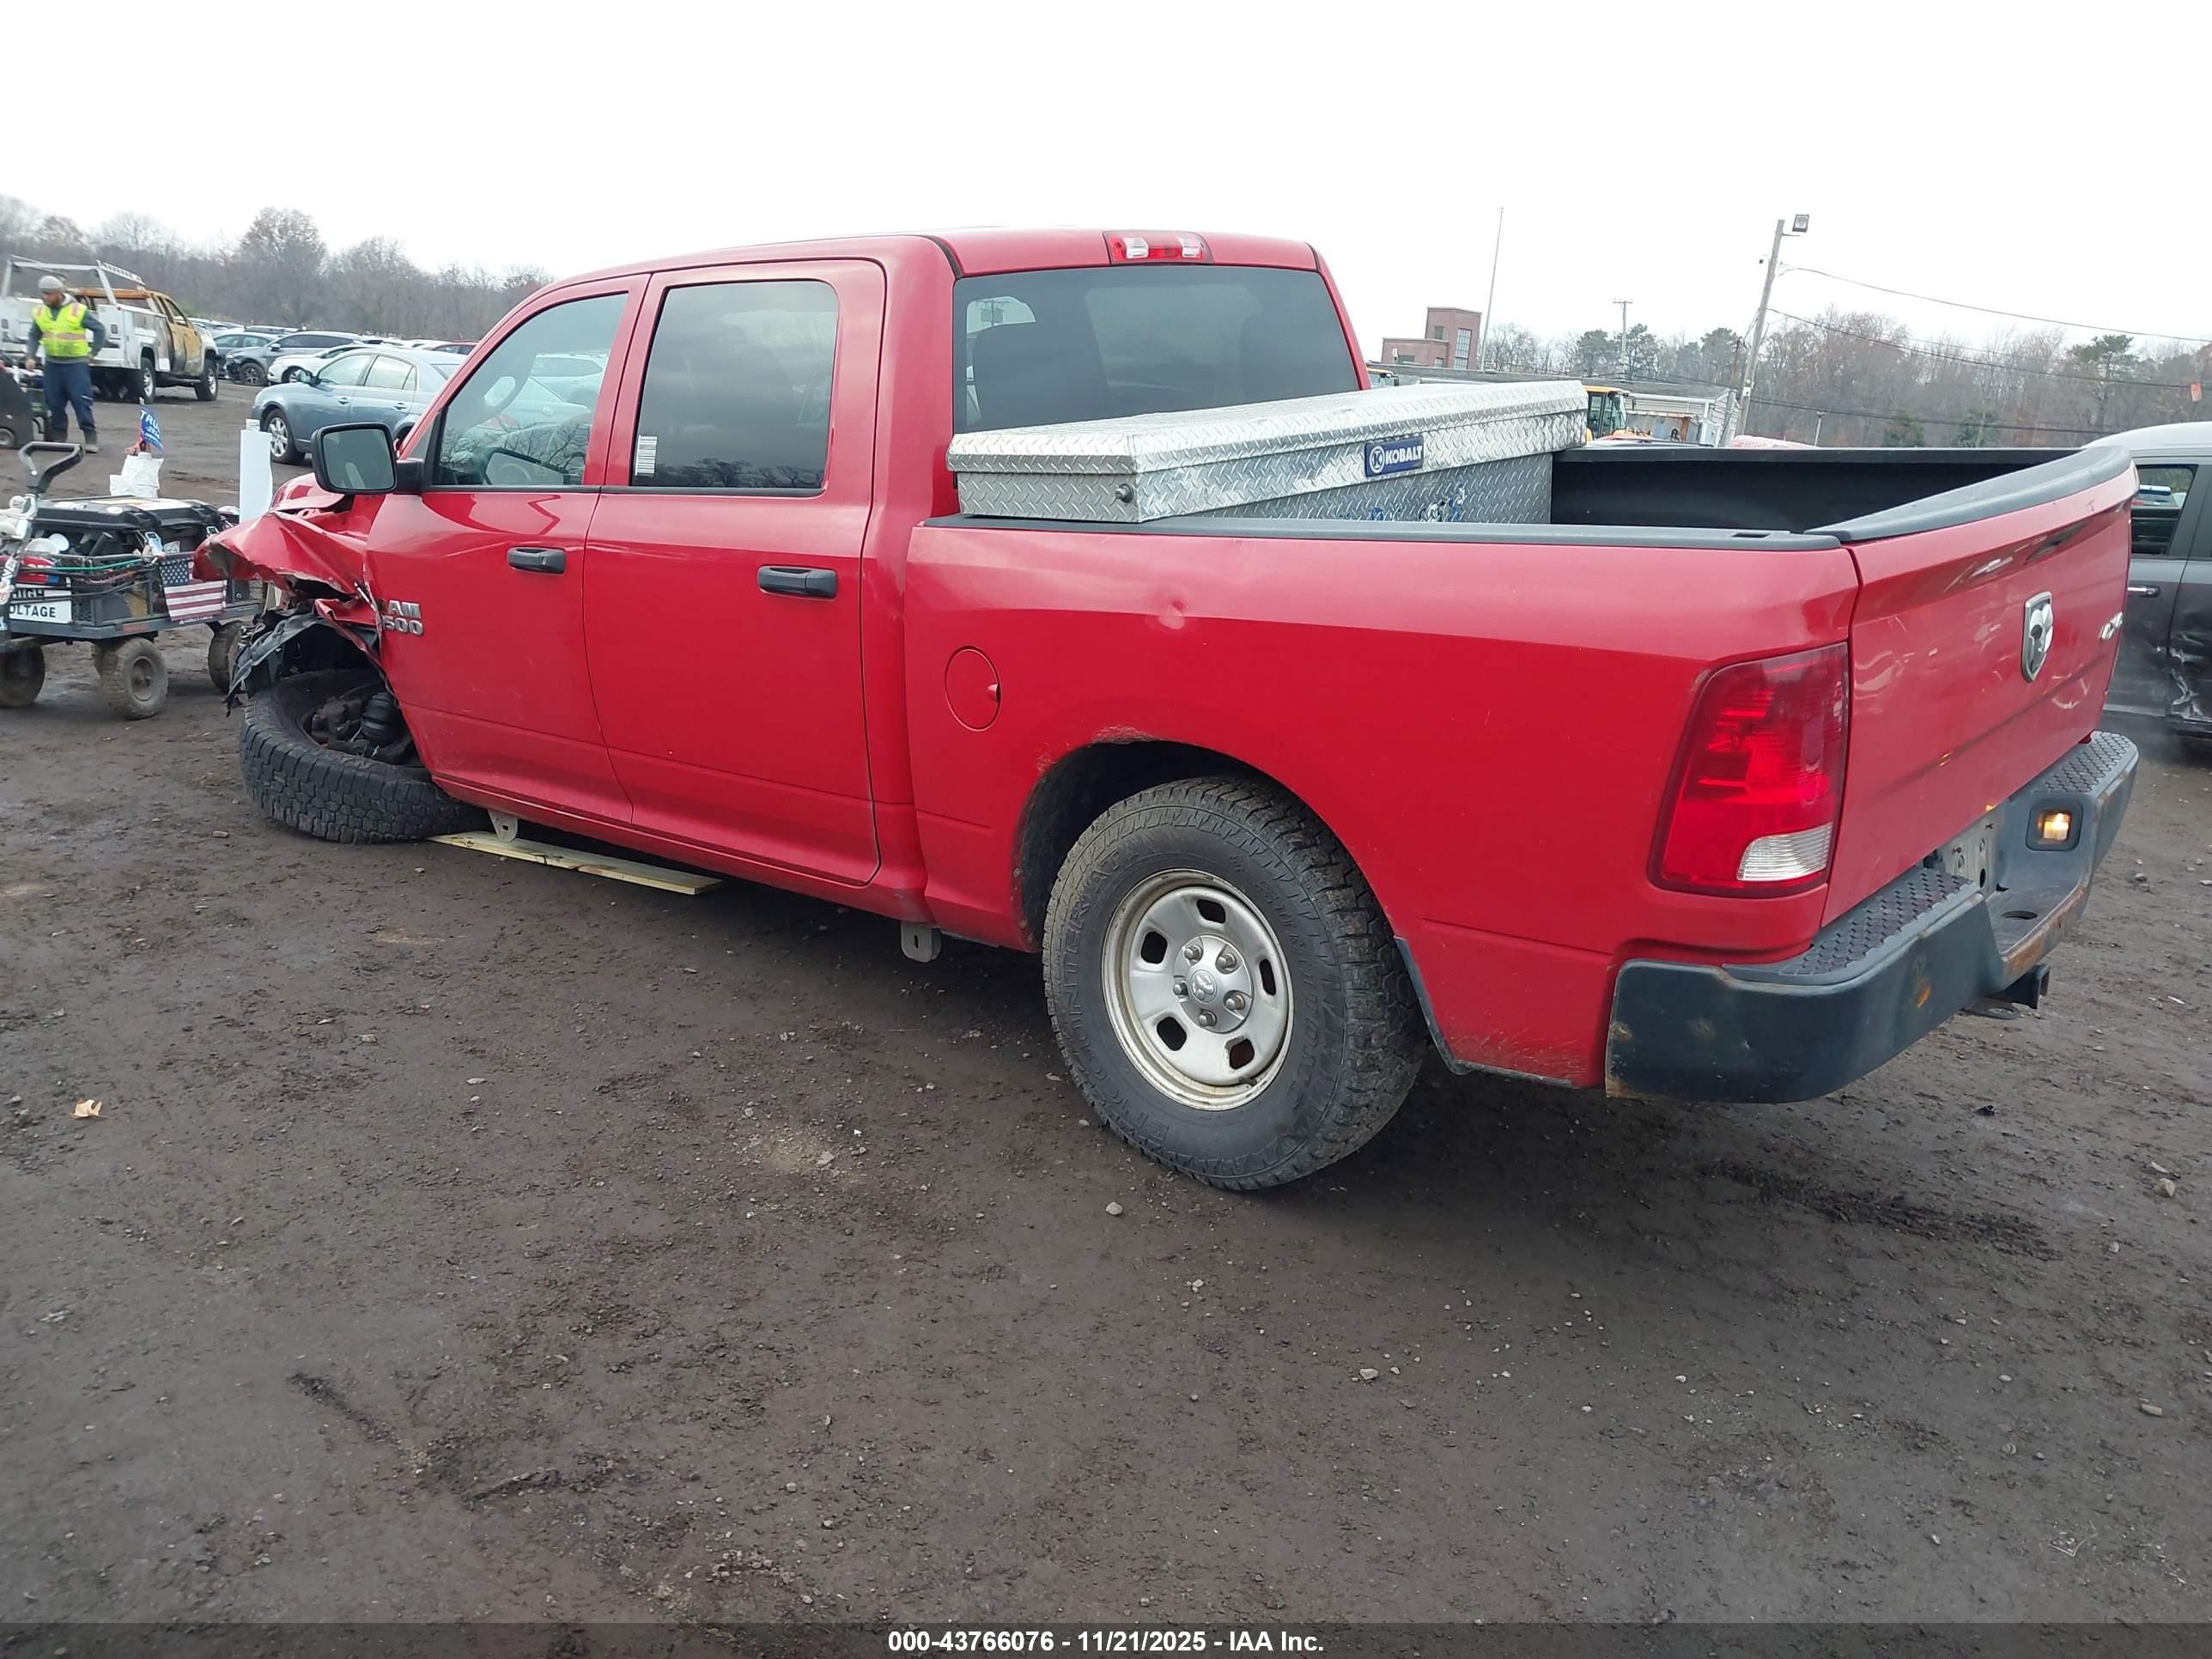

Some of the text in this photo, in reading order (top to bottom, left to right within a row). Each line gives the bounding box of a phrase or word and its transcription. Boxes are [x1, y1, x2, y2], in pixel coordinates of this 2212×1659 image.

[140, 410, 161, 434] TRU
[1385, 446, 1423, 465] KOBALT
[9, 604, 57, 618] OLTAGE
[388, 599, 422, 619] AM
[381, 614, 423, 636] 500
